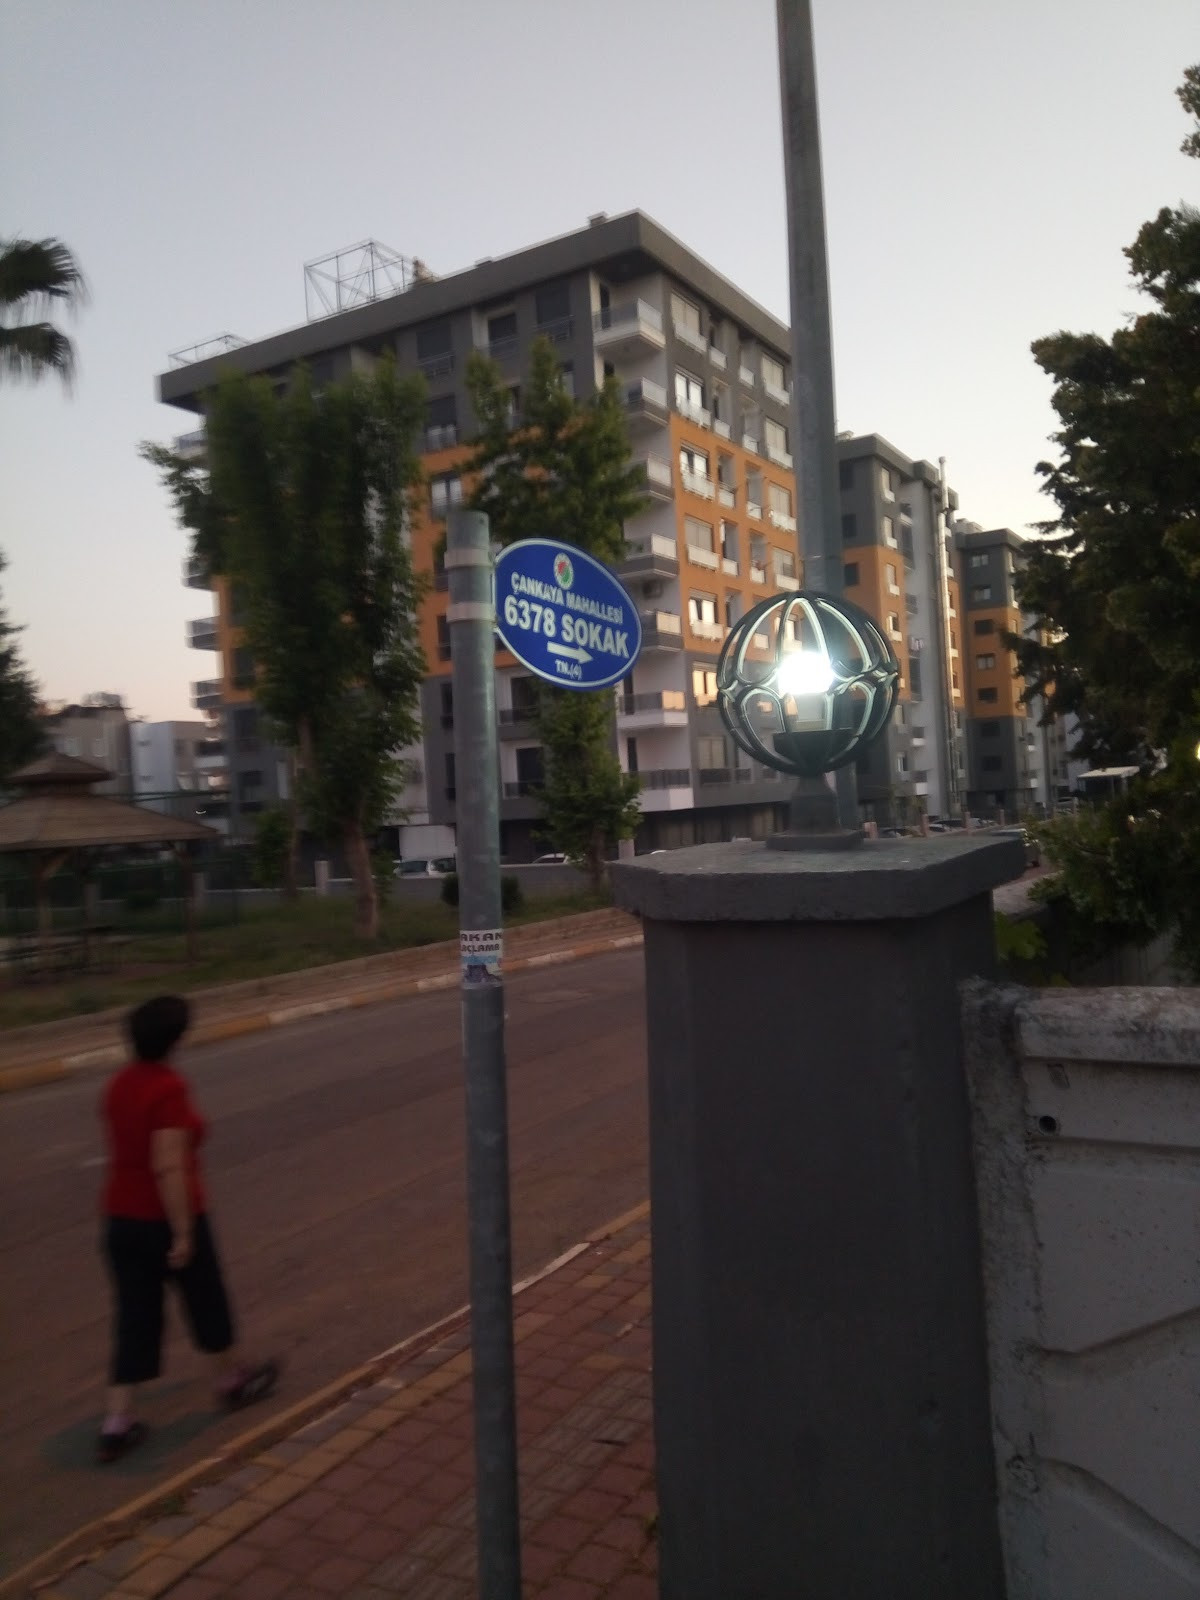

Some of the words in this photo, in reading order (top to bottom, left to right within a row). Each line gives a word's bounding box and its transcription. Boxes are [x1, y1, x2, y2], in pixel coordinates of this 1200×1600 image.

[504, 594, 557, 638] 6378
[561, 613, 630, 659] SOKAK
[511, 571, 565, 606] ÇANKAYA
[566, 592, 624, 624] MAHALLESİ
